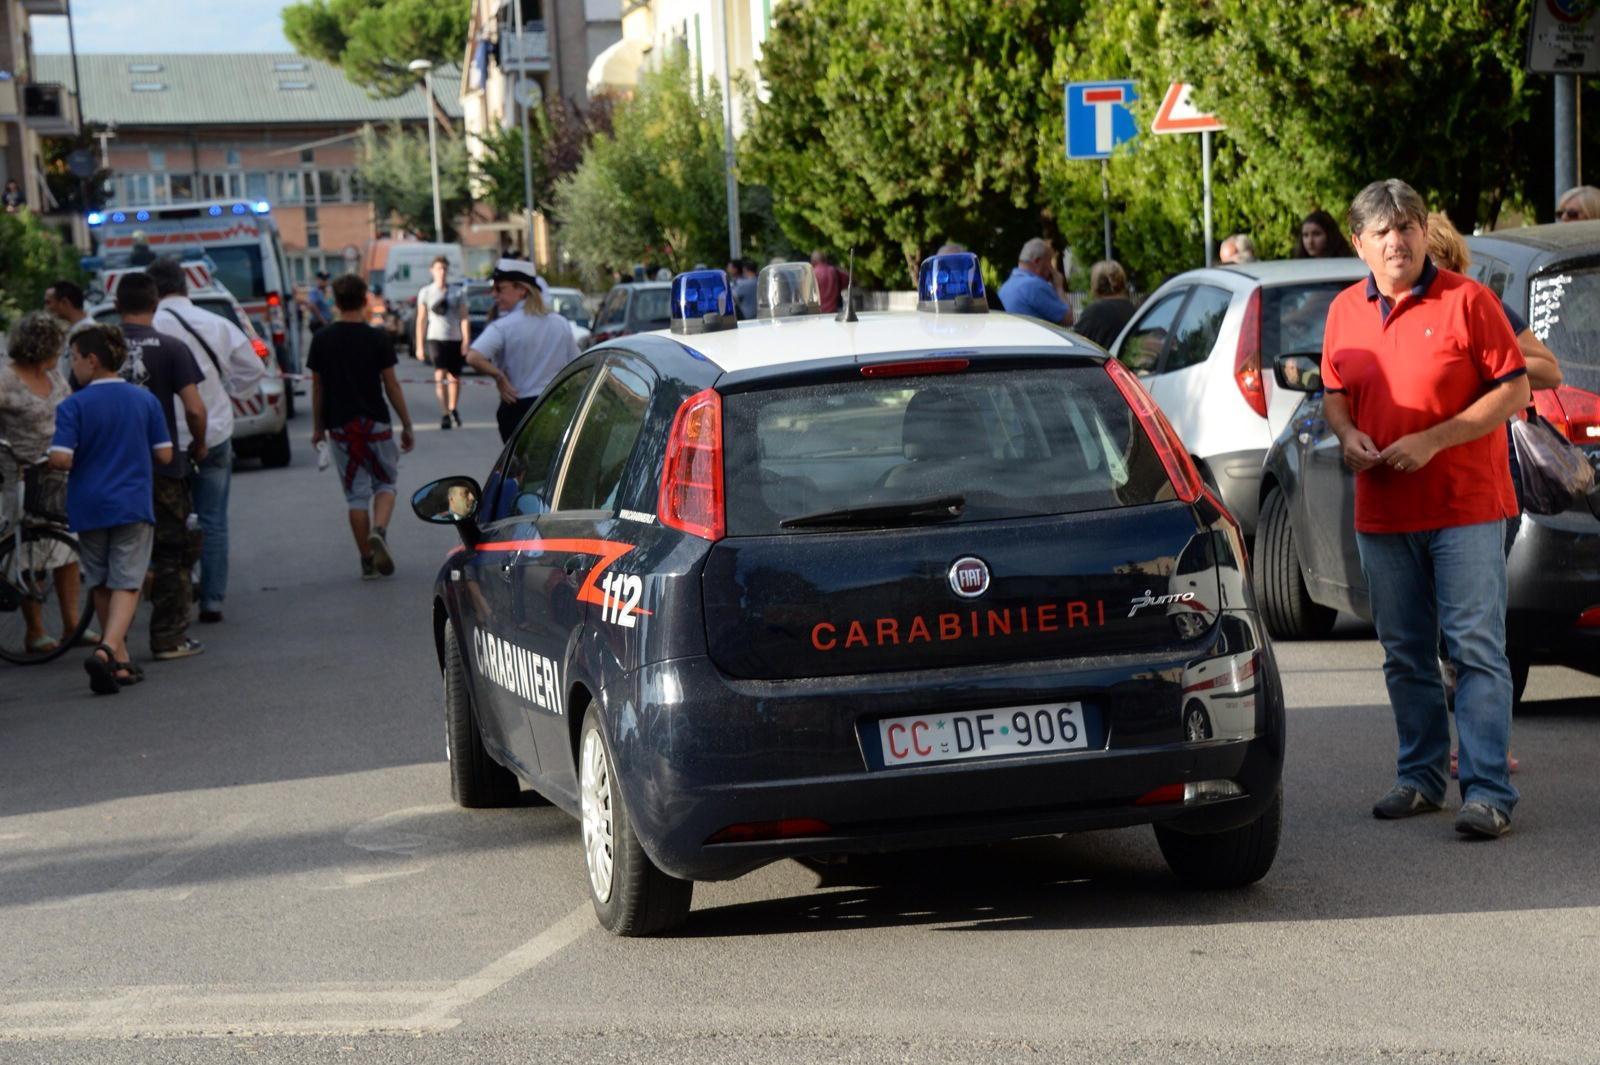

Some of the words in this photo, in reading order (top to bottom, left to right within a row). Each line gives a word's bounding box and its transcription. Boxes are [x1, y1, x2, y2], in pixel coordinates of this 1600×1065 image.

[602, 571, 643, 628] 112
[959, 568, 981, 587] FIAT
[811, 600, 1105, 650] CARABINIERI
[473, 626, 563, 715] CARABINIERI
[888, 720, 932, 759] CC
